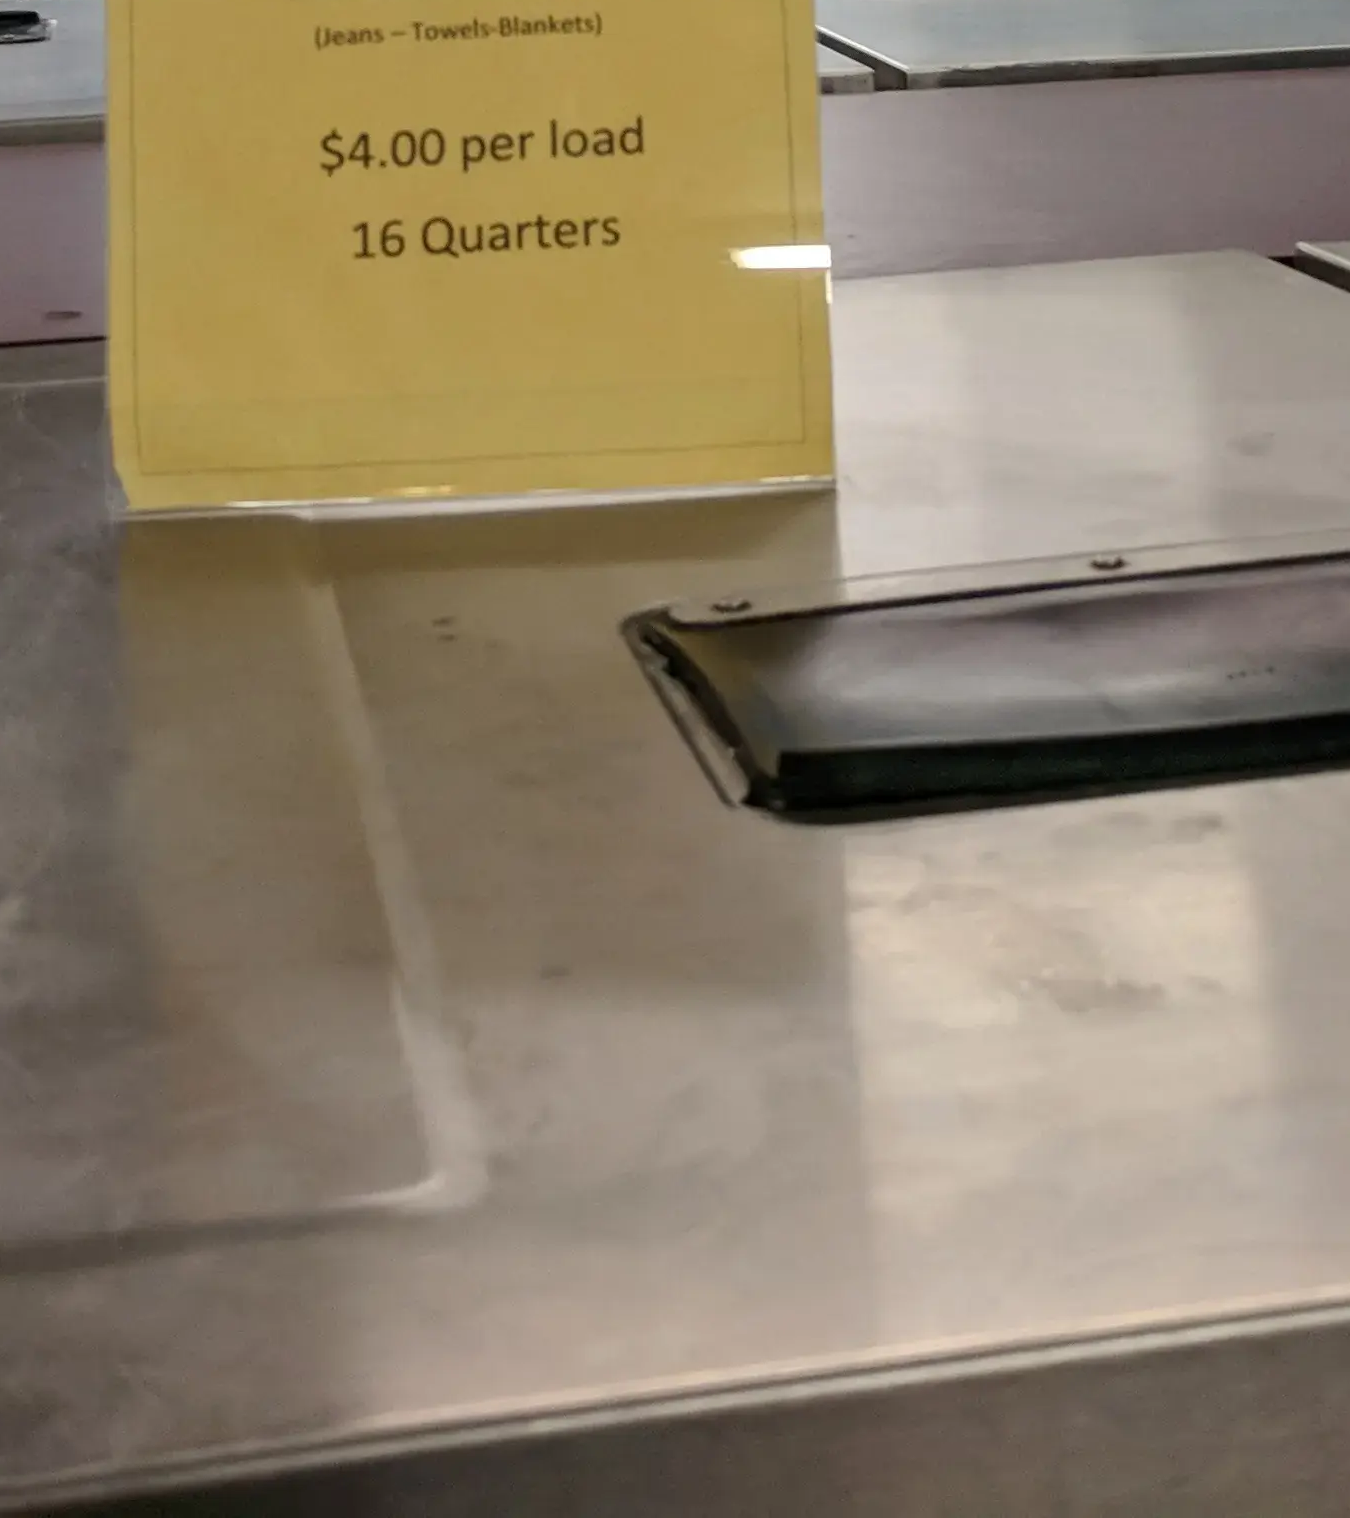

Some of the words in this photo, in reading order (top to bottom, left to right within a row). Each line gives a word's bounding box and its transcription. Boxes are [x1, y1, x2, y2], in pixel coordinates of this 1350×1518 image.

[313, 25, 385, 52] (Jeans
[412, 11, 603, 42] Towels-Blankets)
[319, 128, 447, 178] $4.00
[460, 130, 536, 174] per
[549, 114, 645, 159] load
[352, 219, 407, 260] 16
[420, 214, 622, 259] Quarters
